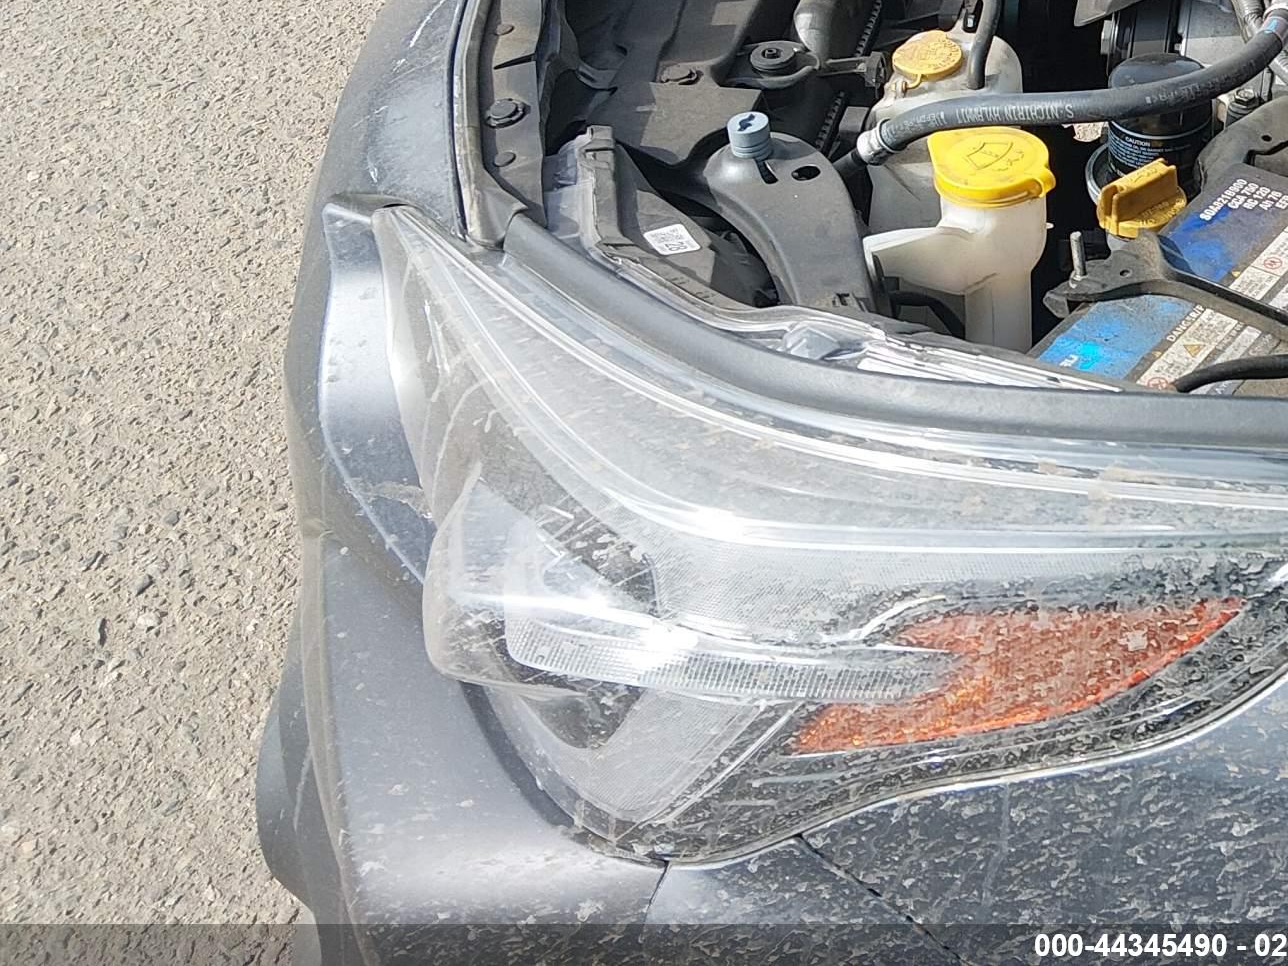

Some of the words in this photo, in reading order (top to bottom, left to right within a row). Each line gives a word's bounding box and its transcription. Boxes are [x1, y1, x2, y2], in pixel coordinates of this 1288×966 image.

[1124, 136, 1151, 147] CAUTION
[1227, 196, 1247, 209] CCA
[1242, 197, 1259, 210] RC
[1252, 186, 1271, 201] 120
